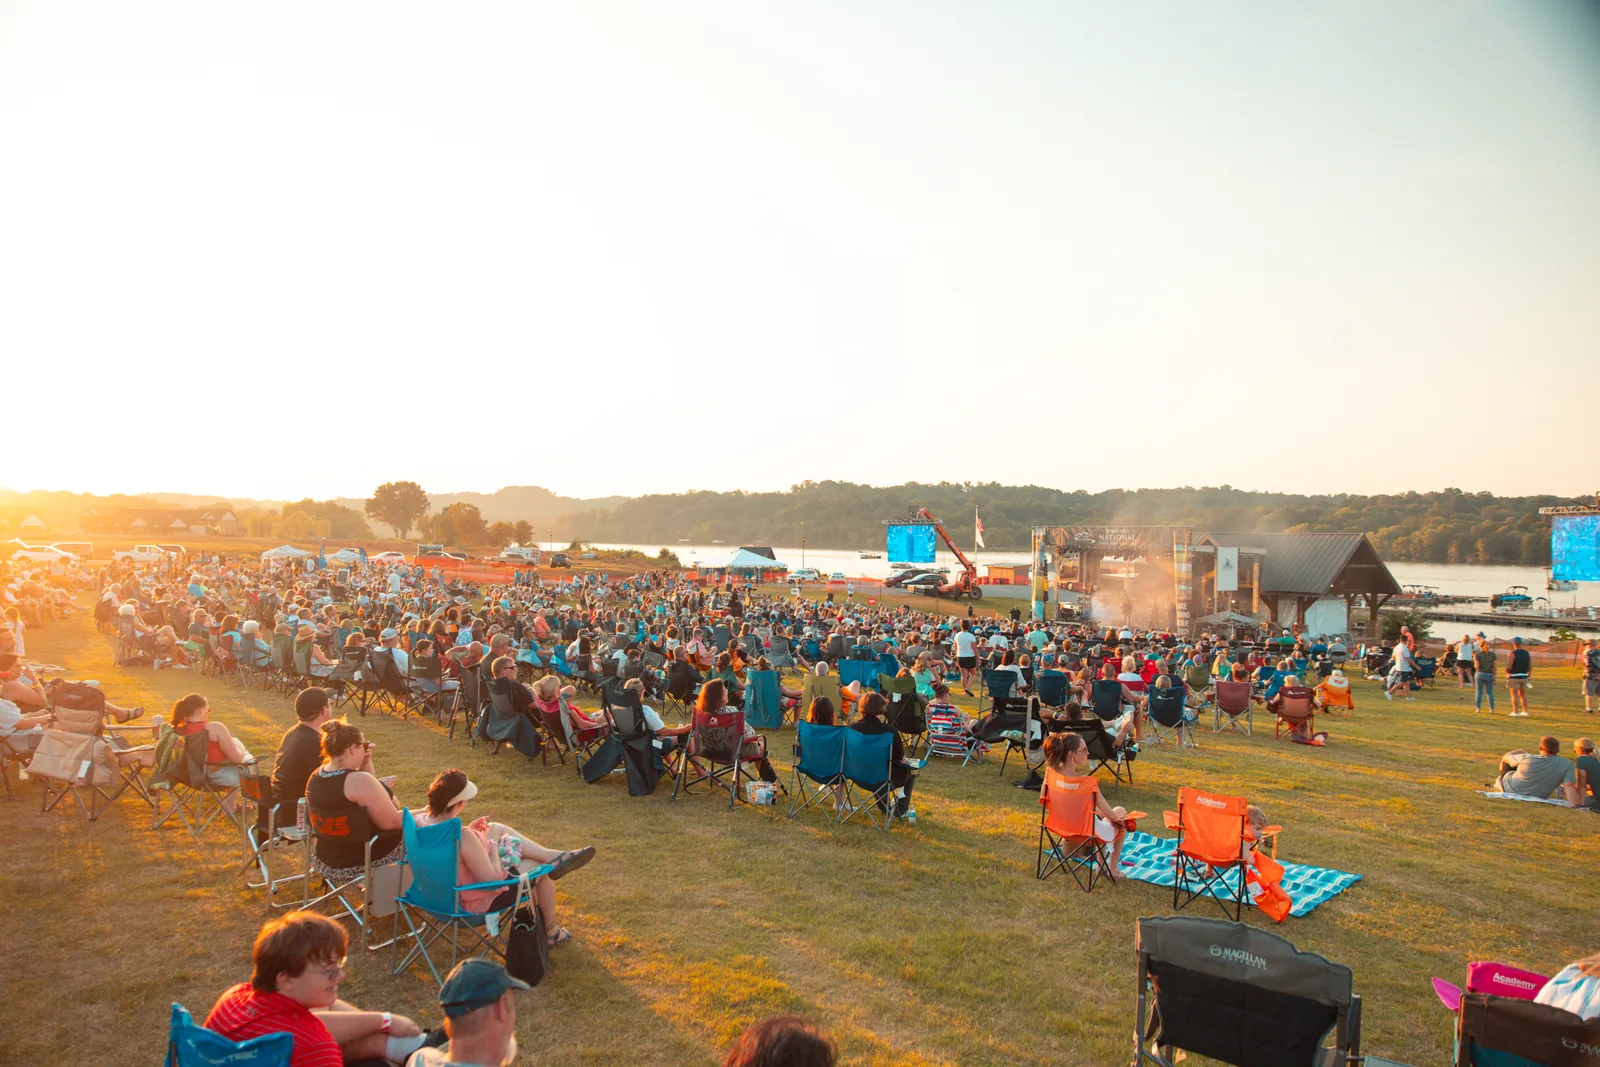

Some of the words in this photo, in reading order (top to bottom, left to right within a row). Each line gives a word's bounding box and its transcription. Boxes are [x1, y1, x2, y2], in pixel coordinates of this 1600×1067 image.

[1197, 796, 1227, 808] Academy
[1222, 947, 1266, 966] MAGELLAN
[1493, 972, 1536, 989] Academy
